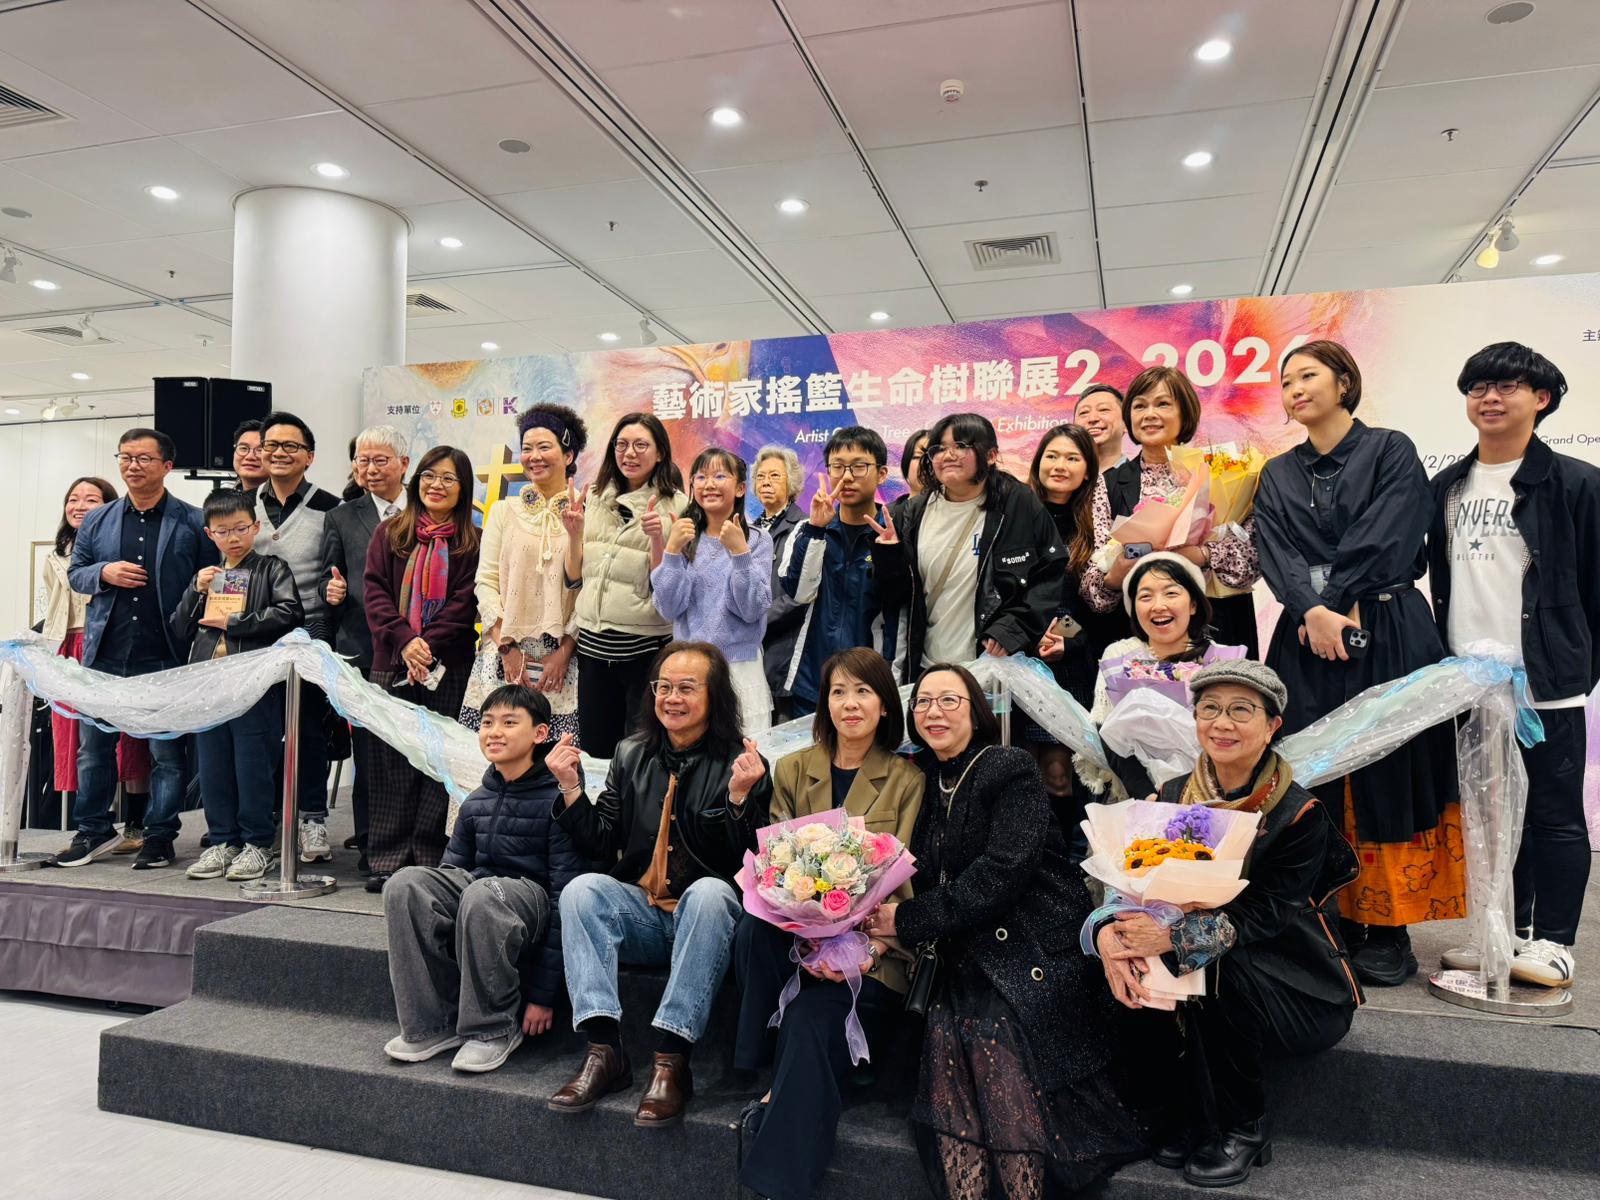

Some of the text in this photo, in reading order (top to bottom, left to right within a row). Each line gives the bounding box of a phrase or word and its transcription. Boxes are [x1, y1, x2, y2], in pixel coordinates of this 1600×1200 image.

[387, 404, 421, 415] 支持單位
[795, 426, 830, 444] Artist
[883, 424, 911, 439] Tree
